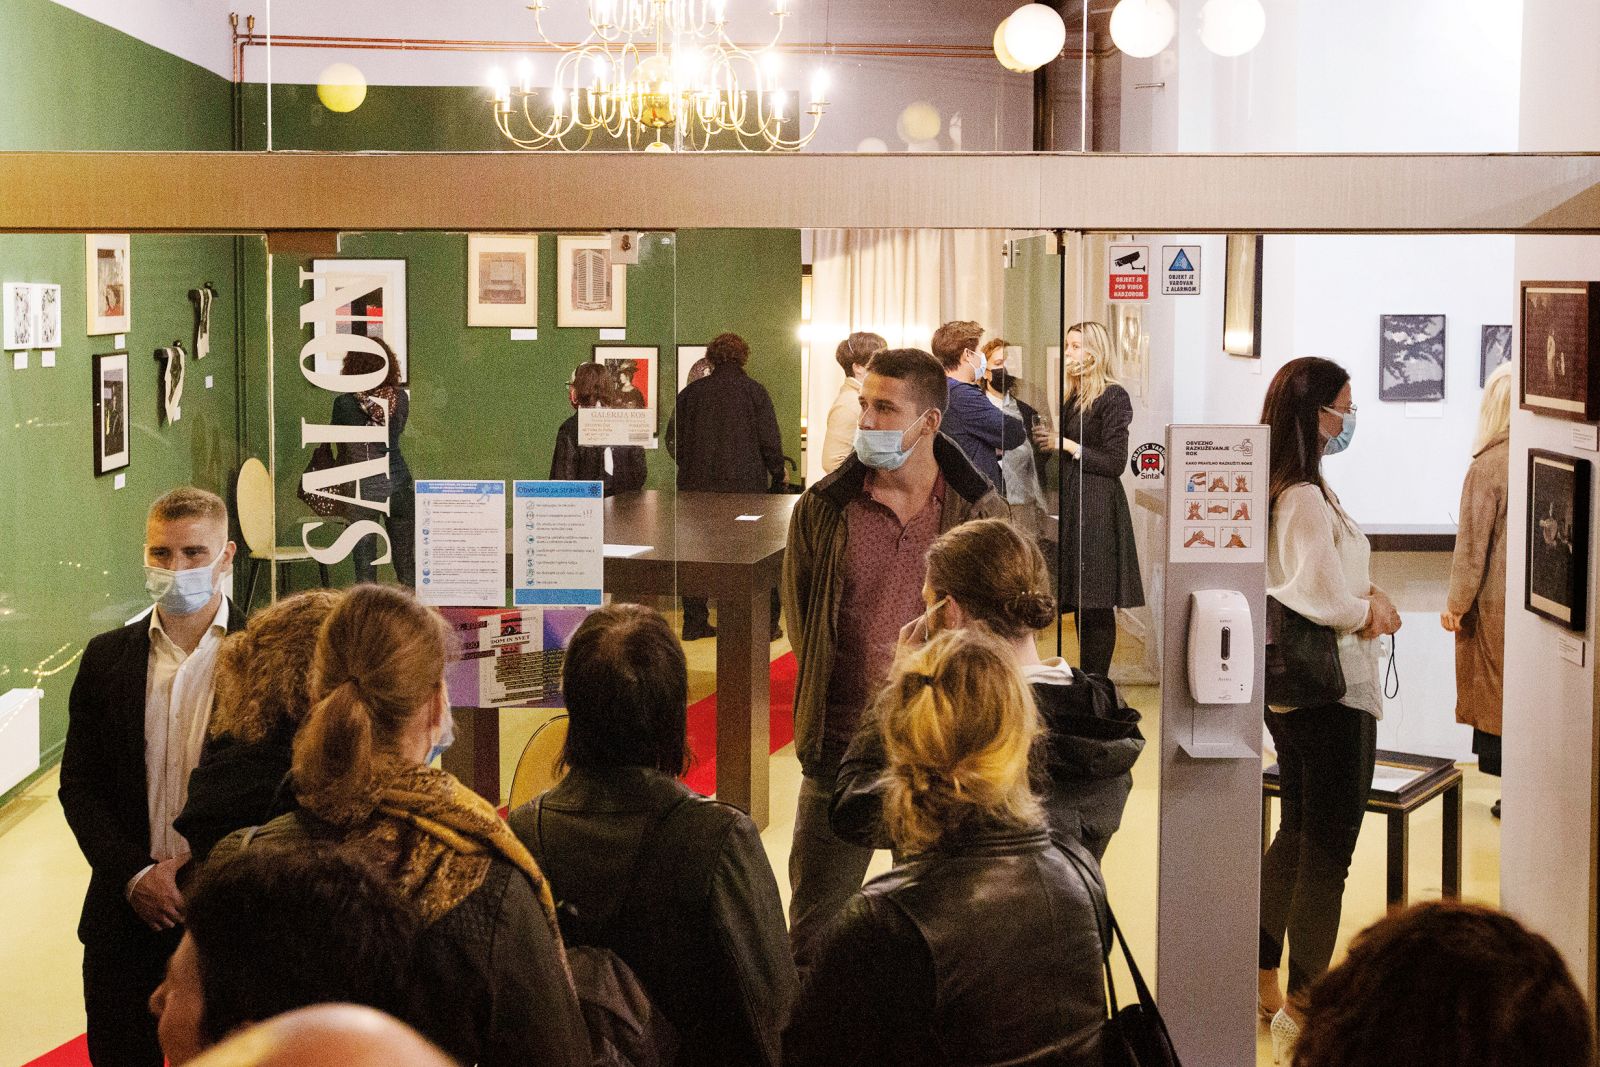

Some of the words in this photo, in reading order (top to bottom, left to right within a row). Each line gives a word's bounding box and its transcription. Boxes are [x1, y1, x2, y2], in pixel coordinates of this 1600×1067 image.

[299, 266, 392, 565] SALON
[1131, 444, 1149, 461] OBJEKT
[1140, 472, 1160, 480] Sintal
[491, 637, 506, 645] DOM
[506, 635, 513, 643] IN
